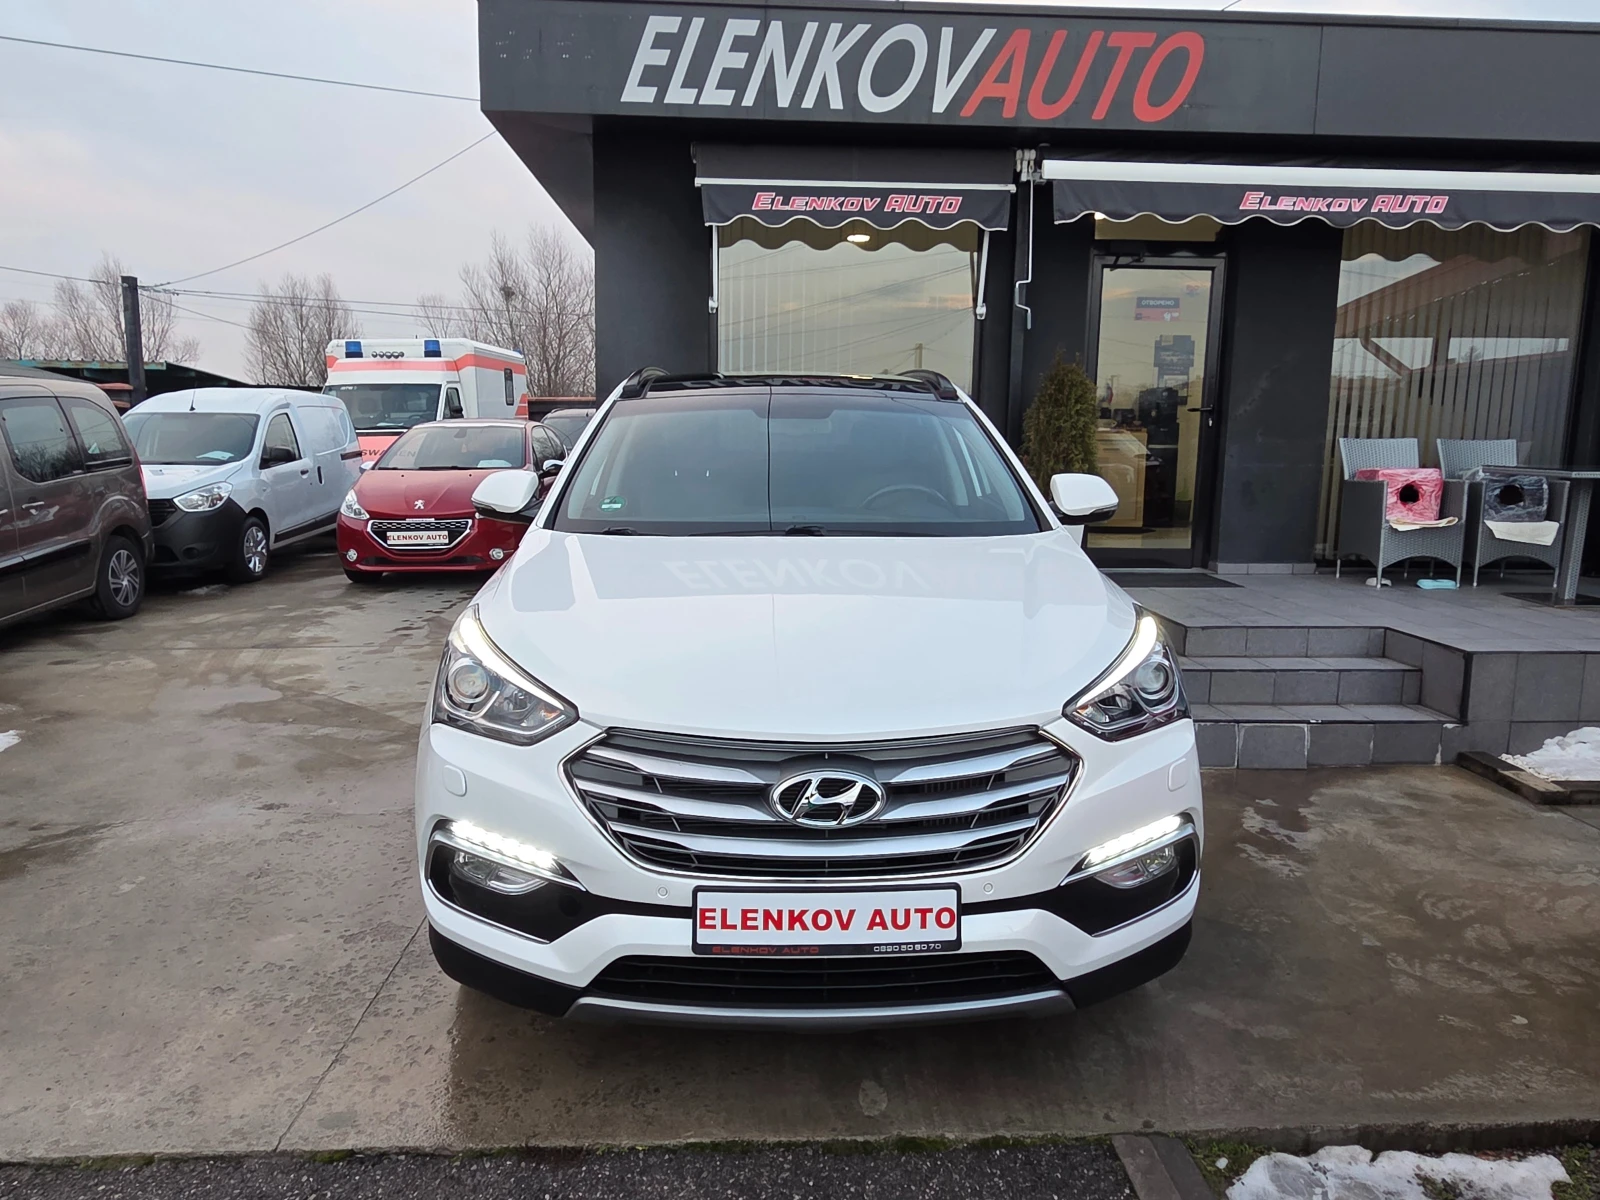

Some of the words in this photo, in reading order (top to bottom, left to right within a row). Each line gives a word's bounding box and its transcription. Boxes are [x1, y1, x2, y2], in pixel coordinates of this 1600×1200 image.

[620, 15, 997, 113] ELENKOV
[960, 28, 1205, 122] AUTO
[884, 193, 963, 214] AUTO
[1370, 194, 1449, 214] AUTO
[699, 907, 857, 931] ELENKOV
[866, 906, 956, 931] AUTO
[712, 946, 777, 954] ELENKOV
[782, 946, 819, 954] AUTO
